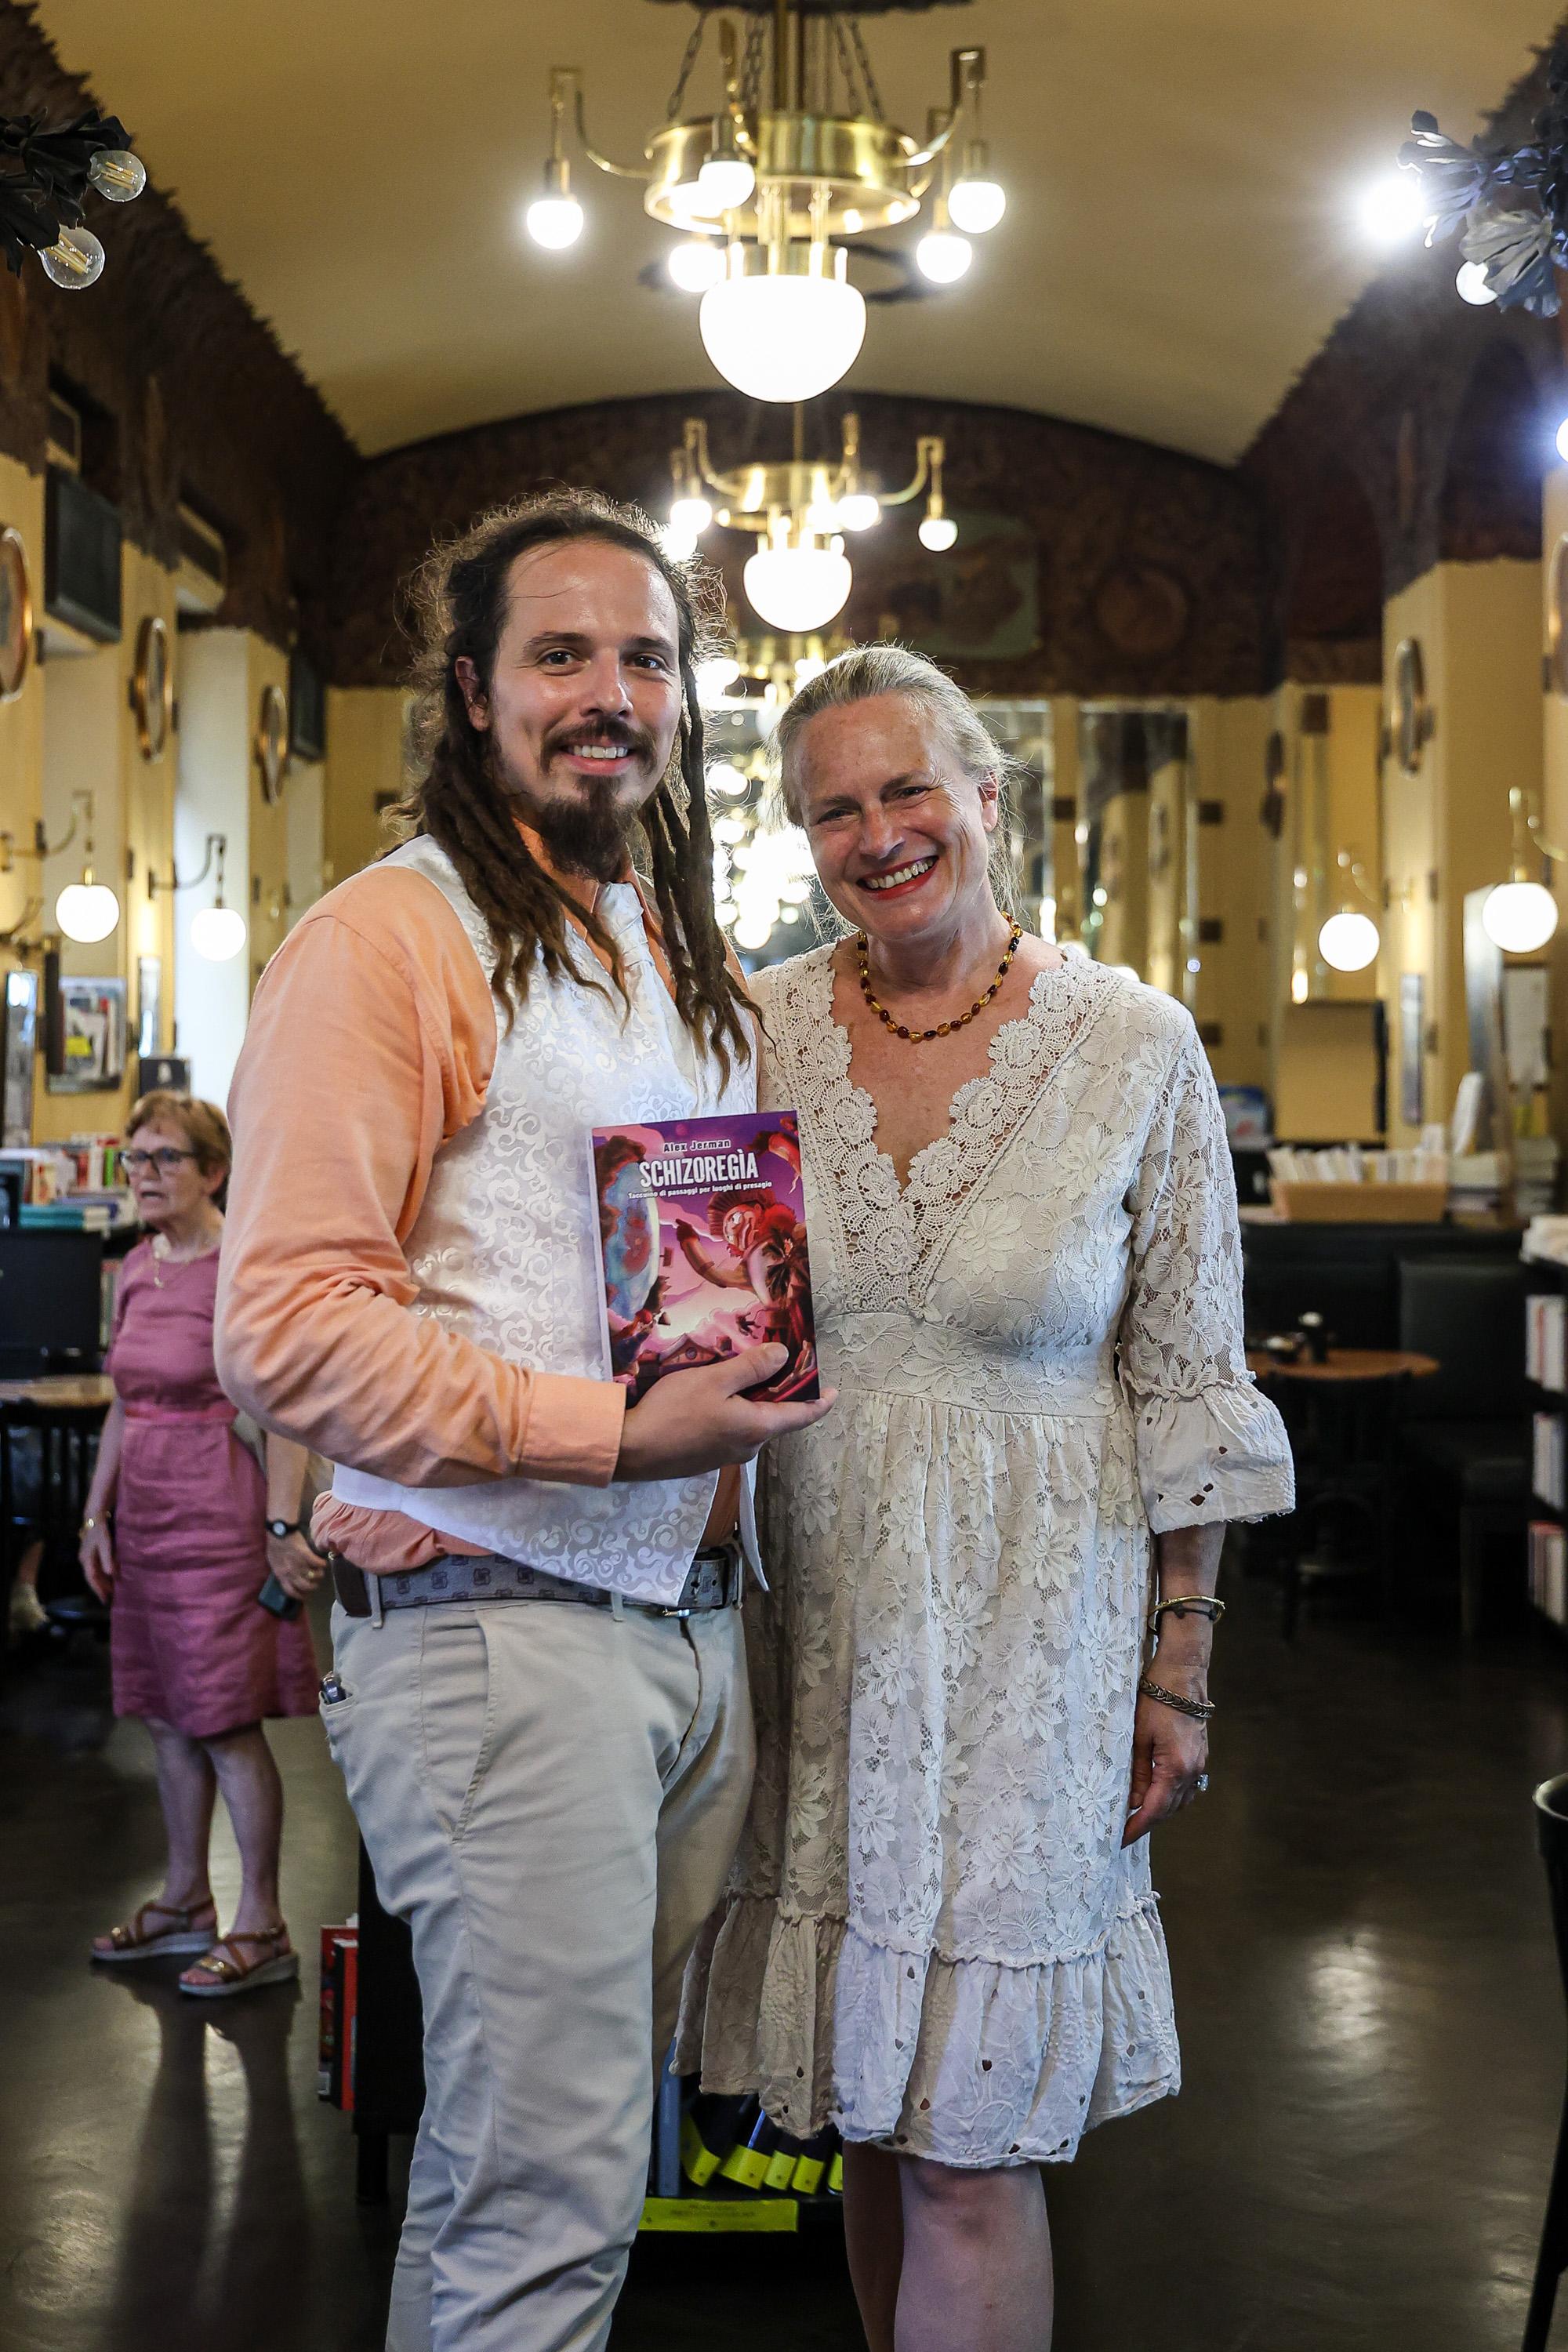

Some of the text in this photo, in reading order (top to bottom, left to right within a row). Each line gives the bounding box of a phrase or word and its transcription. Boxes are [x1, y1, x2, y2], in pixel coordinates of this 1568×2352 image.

[663, 1140, 730, 1152] Alex Jerman
[639, 1148, 759, 1188] SCHIZOREGÌA
[668, 1187, 698, 1196] passaggi
[742, 1181, 772, 1190] presagio
